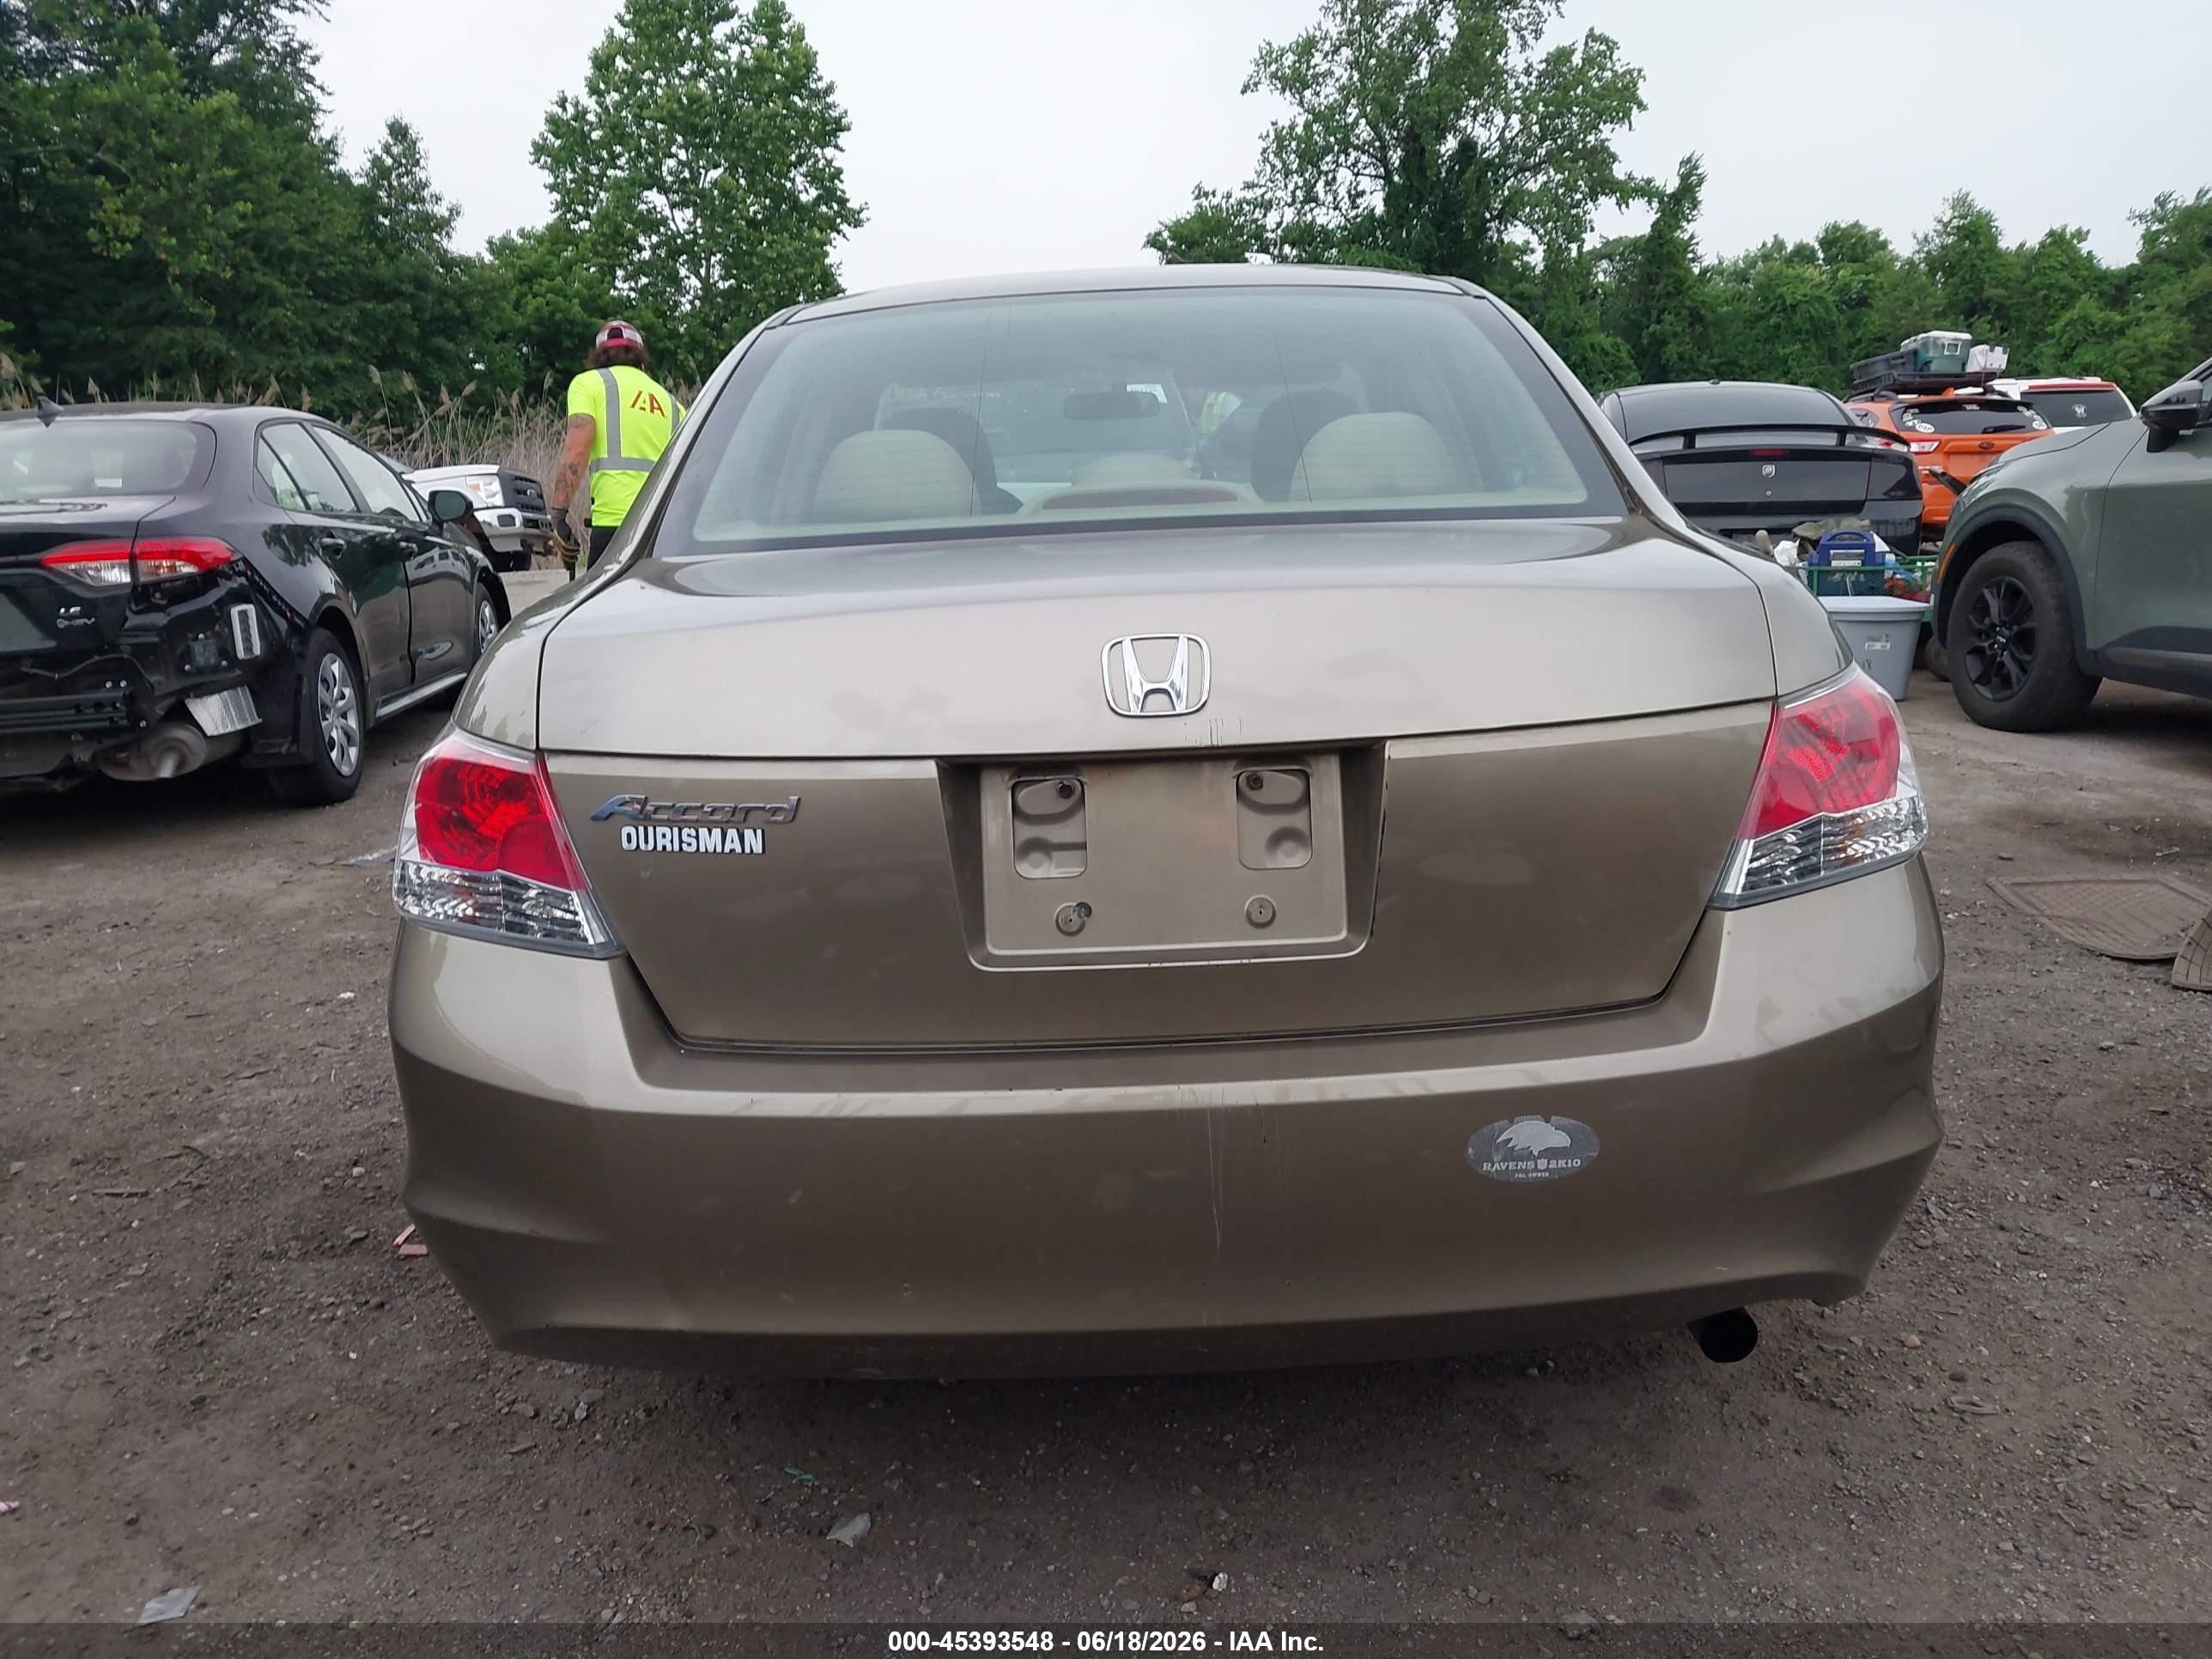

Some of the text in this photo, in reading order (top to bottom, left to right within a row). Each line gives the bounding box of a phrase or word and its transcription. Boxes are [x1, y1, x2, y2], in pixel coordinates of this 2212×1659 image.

[590, 793, 801, 824] Accord
[621, 824, 766, 855] OURISMAN
[1483, 1160, 1535, 1172] RAVENS
